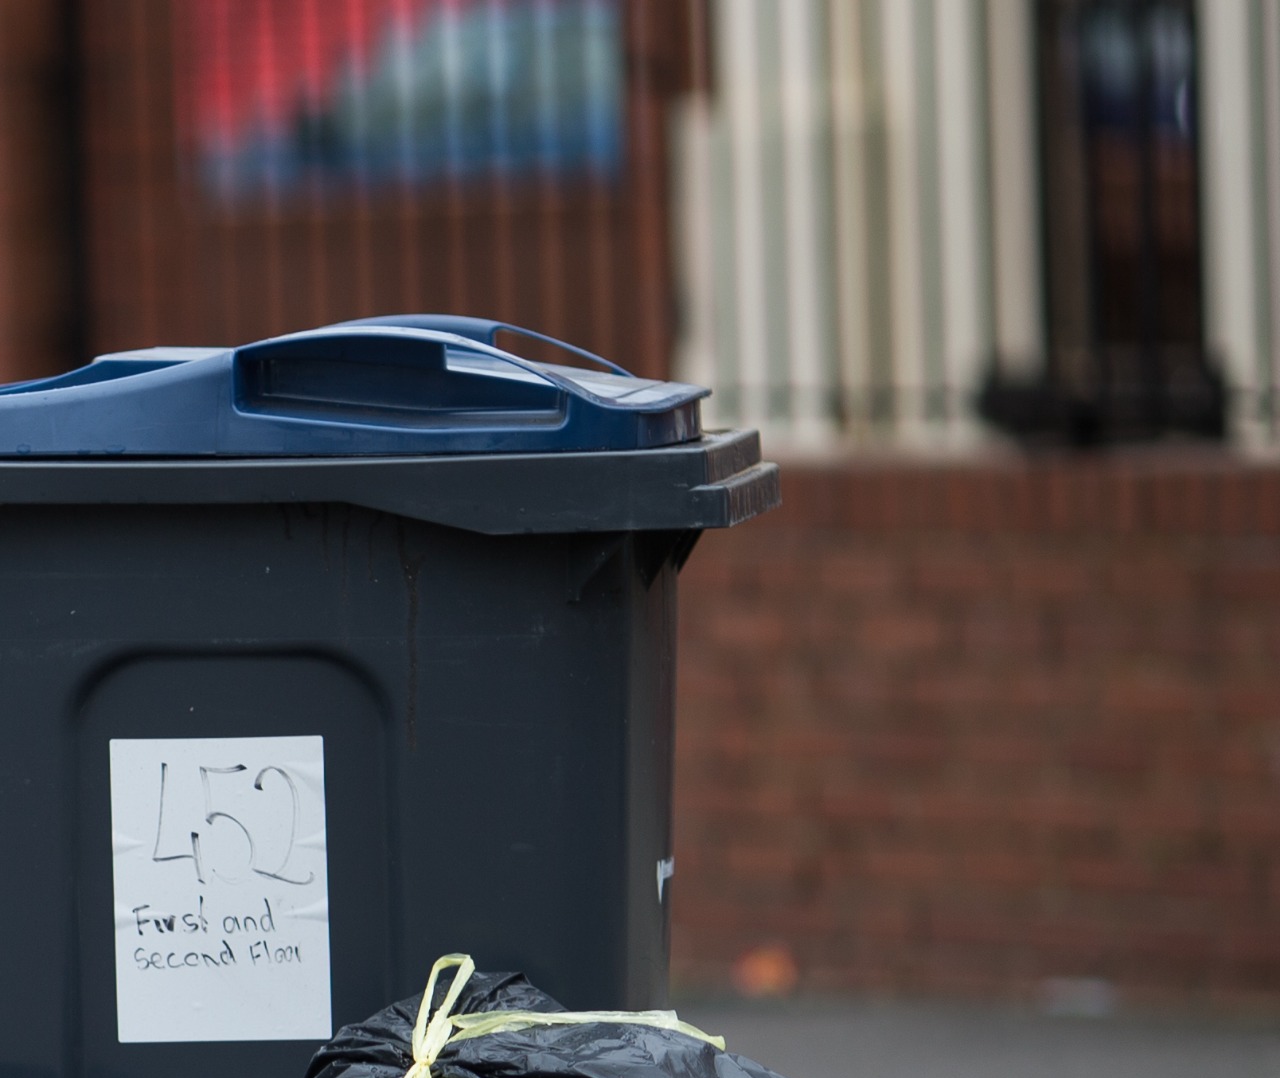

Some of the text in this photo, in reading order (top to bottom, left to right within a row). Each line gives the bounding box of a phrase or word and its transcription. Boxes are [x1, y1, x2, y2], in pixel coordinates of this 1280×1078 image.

[152, 762, 315, 885] 452
[132, 895, 276, 936] First and
[249, 940, 302, 966] Floor
